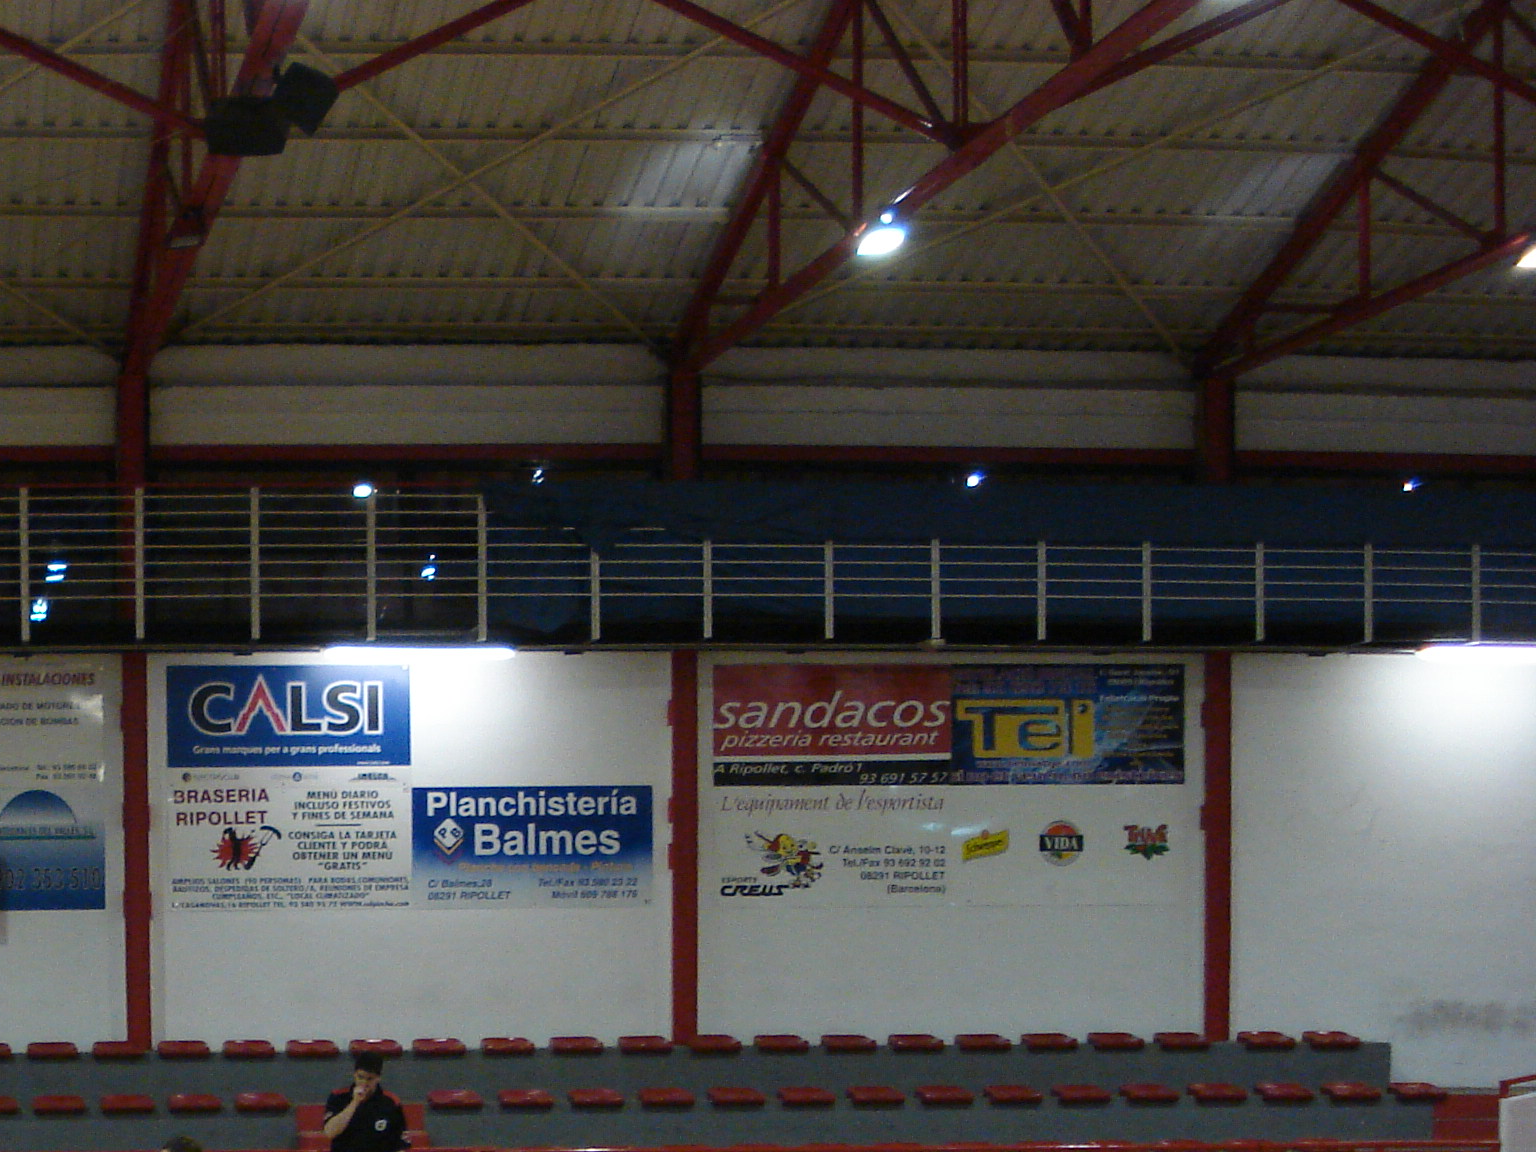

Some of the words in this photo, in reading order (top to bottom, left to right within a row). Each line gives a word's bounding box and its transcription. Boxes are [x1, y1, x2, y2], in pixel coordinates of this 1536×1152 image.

[2, 672, 96, 687] INSTALACIONES
[188, 673, 384, 736] CALSI
[714, 690, 951, 729] sandacos
[720, 730, 812, 751] pizzeria
[818, 731, 939, 747] restaurant
[318, 743, 382, 755] professionals
[859, 773, 877, 785] 93
[909, 772, 927, 784] 57
[930, 772, 949, 784] 57
[173, 788, 270, 804] BRASERIA
[341, 791, 379, 800] DIARIO
[835, 793, 853, 810] de
[294, 801, 339, 811] INCLUSO
[342, 800, 391, 810] FESTIVOS
[426, 789, 638, 817] Planchistería
[176, 810, 268, 826] RIPOLLET
[301, 812, 331, 820] FINES
[334, 812, 346, 820] DE
[350, 811, 394, 820] SEMANA
[288, 831, 335, 841] CONSIGA
[339, 831, 351, 840] LA
[355, 830, 397, 840] TARJETA
[473, 822, 621, 856] Balmes
[297, 841, 337, 850] CLIENTE
[1043, 836, 1079, 850] VIDA
[292, 851, 339, 861] OBTENER
[342, 851, 357, 860] UN
[720, 884, 789, 897] CREUS
